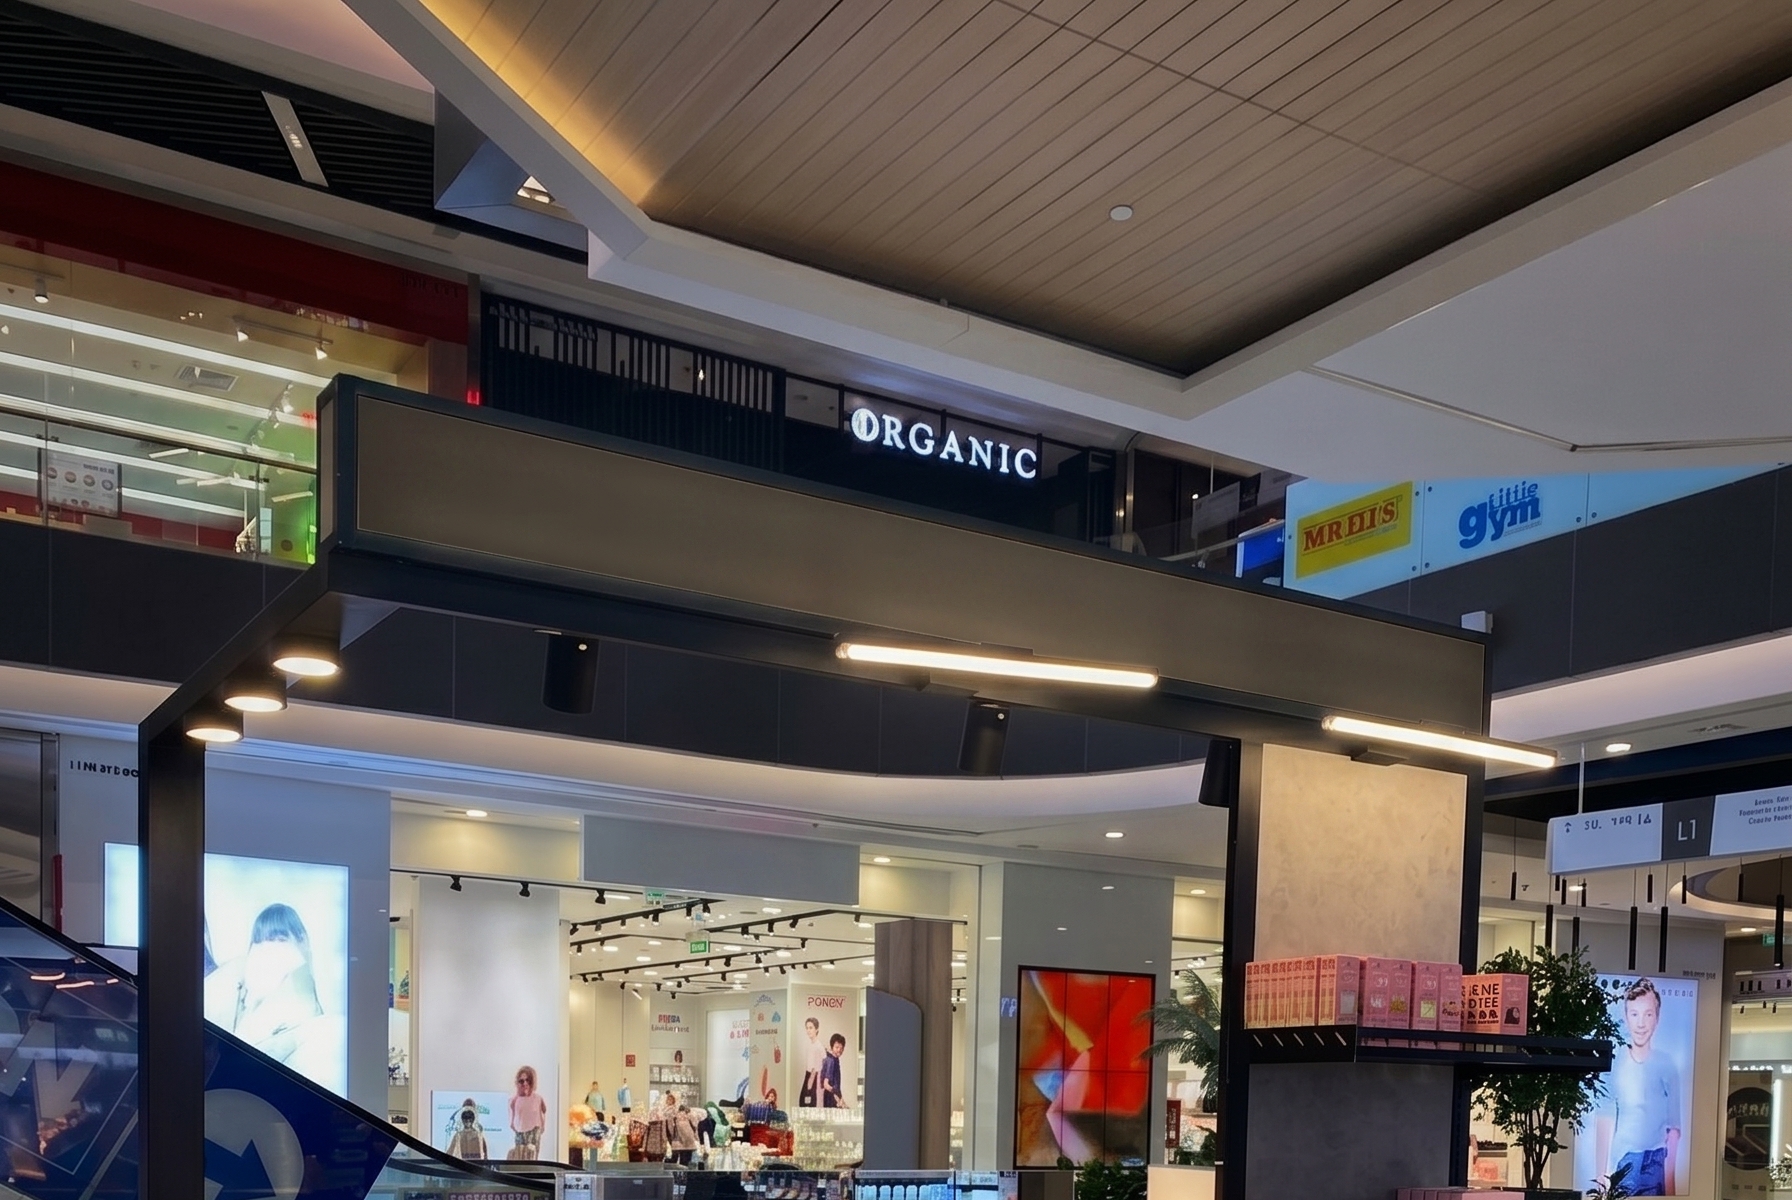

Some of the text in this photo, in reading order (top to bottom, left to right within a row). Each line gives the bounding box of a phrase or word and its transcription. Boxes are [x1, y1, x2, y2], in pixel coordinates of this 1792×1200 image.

[851, 408, 1037, 479] ORGANIC
[1458, 496, 1541, 549] gym
[1677, 819, 1697, 841] L1
